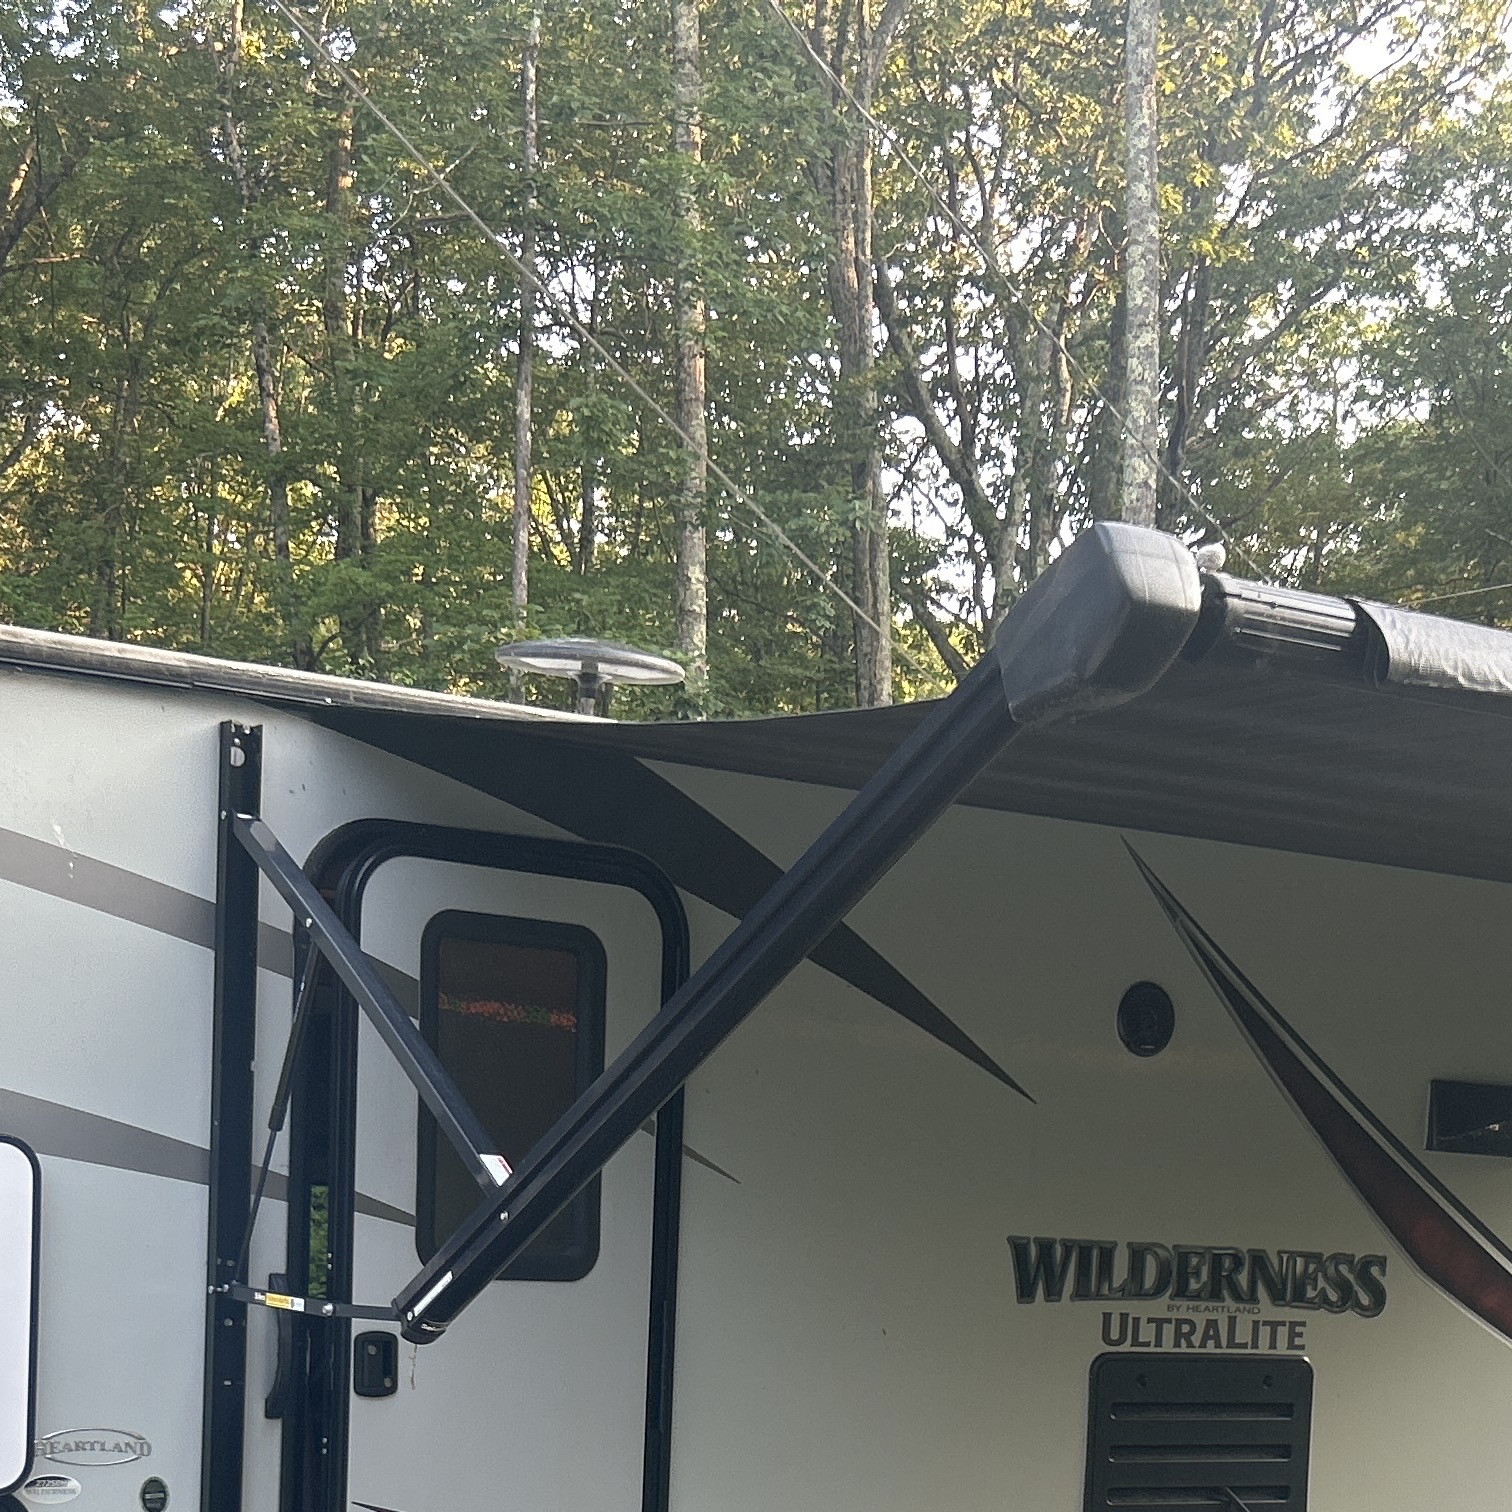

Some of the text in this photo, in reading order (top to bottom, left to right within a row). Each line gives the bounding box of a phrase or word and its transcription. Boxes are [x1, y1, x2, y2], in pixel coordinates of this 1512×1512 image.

[1006, 1235, 1387, 1318] WILDERNESS
[1166, 1303, 1261, 1315] BY HEARTLAND
[34, 1439, 153, 1458] HEARTLAND
